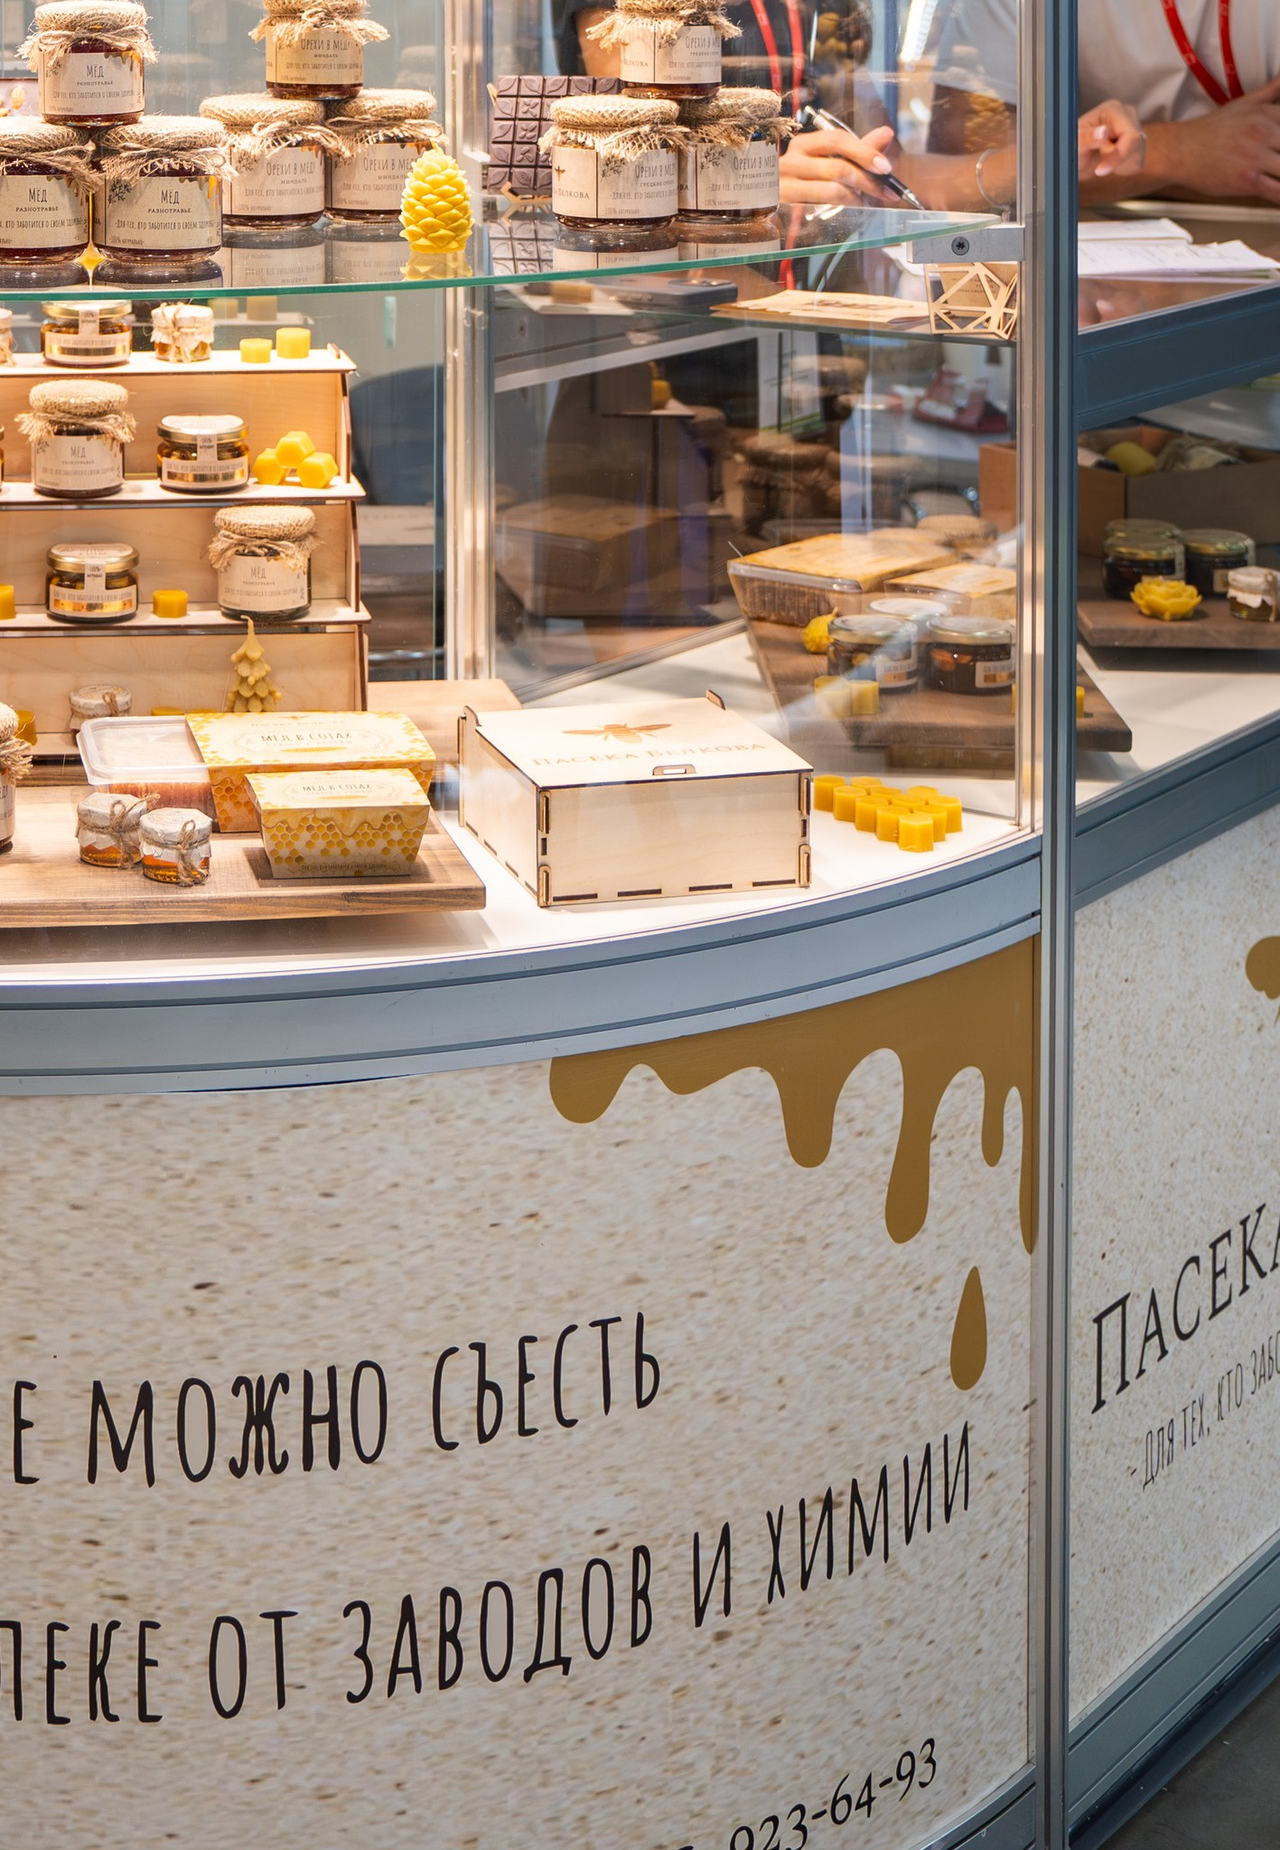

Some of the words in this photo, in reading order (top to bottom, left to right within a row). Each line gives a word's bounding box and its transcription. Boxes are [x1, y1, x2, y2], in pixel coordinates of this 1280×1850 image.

[86, 63, 105, 79] МЁД
[266, 162, 291, 177] ОРЕХИ
[363, 158, 388, 171] ОРЕХИ
[28, 187, 48, 203] МЁД
[160, 189, 180, 205] МЁД
[15, 205, 59, 213] РАЗНОТРАВЬЕ
[532, 752, 639, 766] ПАСЕКА
[86, 1359, 389, 1488] МОЖНО
[431, 1311, 661, 1451] СЪЕСТЬ
[1217, 1363, 1244, 1422] КТО
[208, 1609, 299, 1720] ОТ
[342, 1544, 653, 1704] ЗАВОДОВ
[693, 1520, 732, 1630] И
[765, 1421, 971, 1605] ХИМИИ
